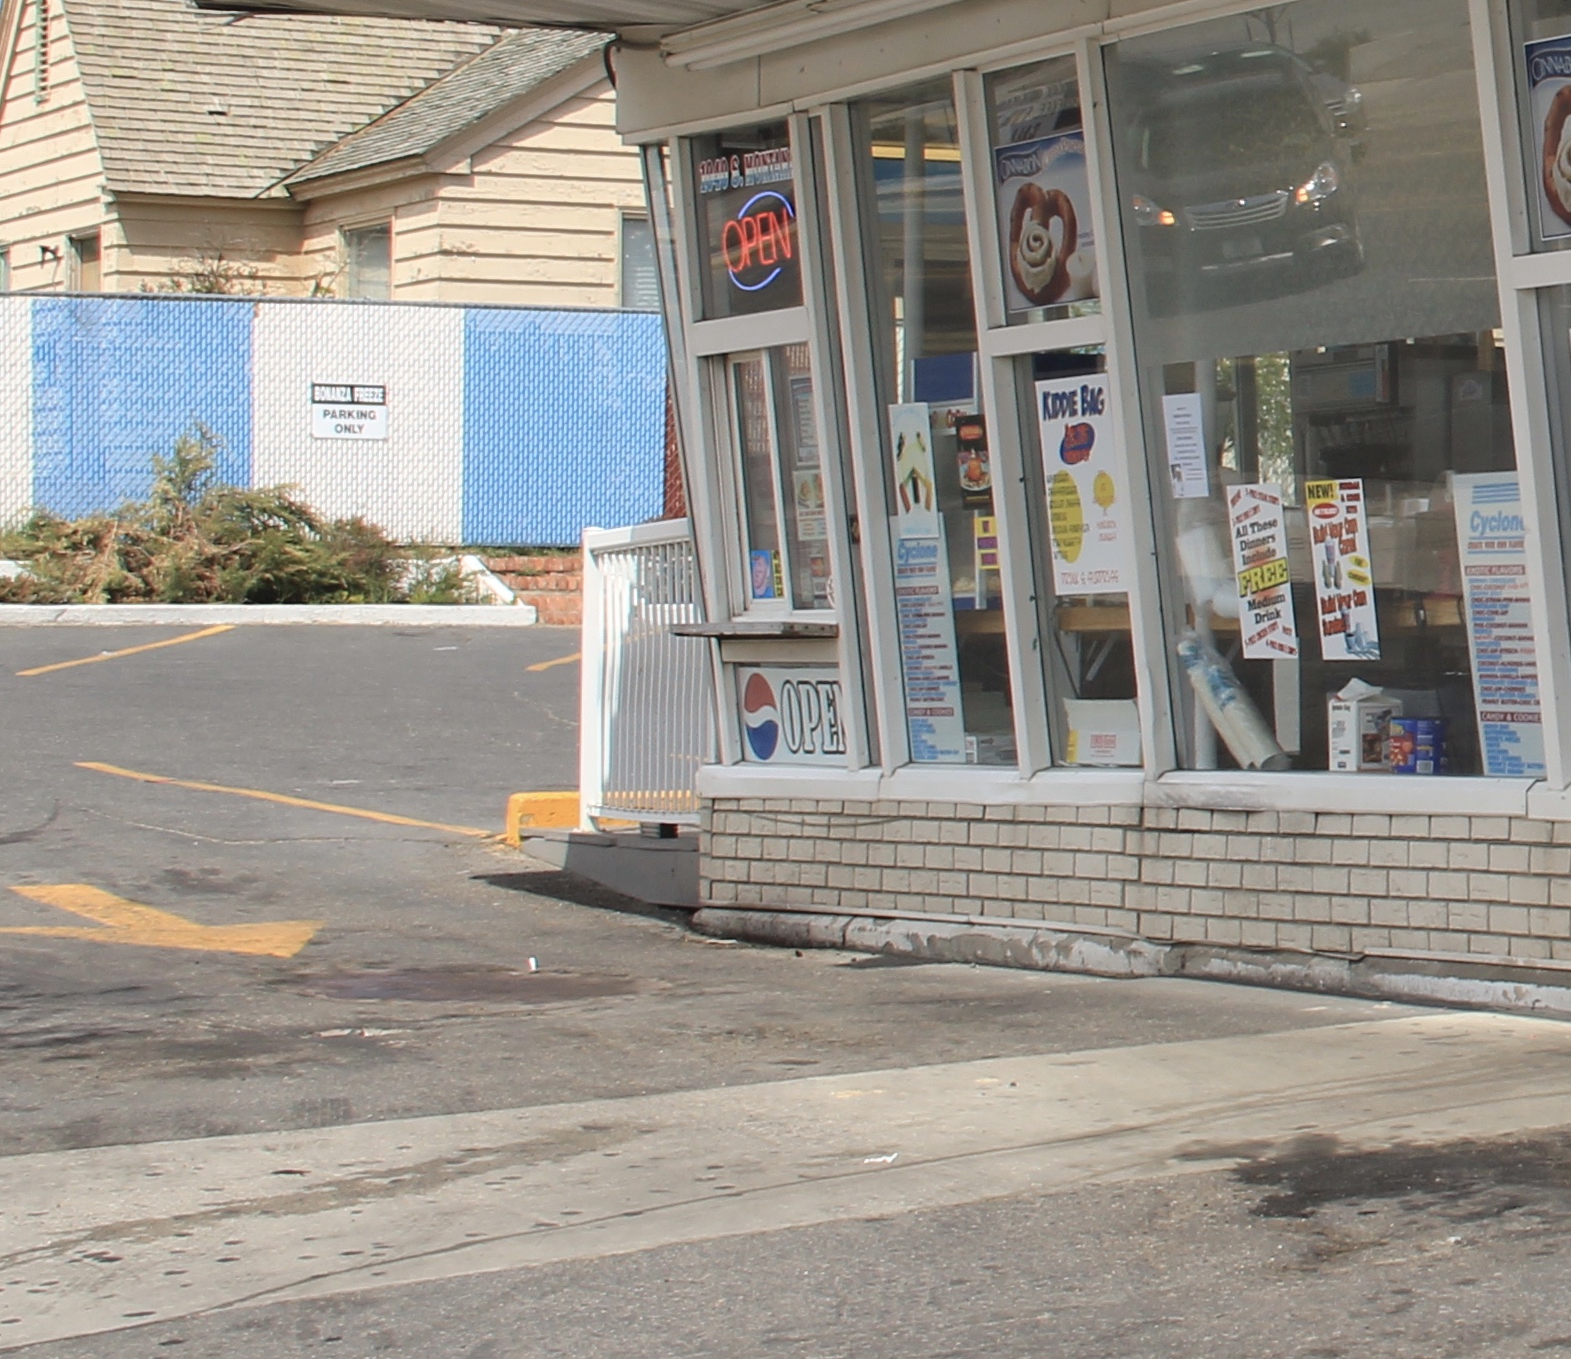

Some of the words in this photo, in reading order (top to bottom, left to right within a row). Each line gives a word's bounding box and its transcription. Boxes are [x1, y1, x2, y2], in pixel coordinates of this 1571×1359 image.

[721, 207, 792, 273] OPEN
[314, 385, 352, 402] BONANZA
[354, 386, 384, 403] FREEZE
[1080, 384, 1104, 417] BAG
[323, 409, 377, 420] PARKING
[334, 423, 365, 434] ONLY
[1307, 483, 1334, 499] NEW!
[1236, 524, 1249, 539] All
[1249, 518, 1278, 534] These
[1240, 534, 1276, 552] Dinners
[1237, 556, 1290, 598] FREE
[1247, 593, 1286, 612] Medium
[1254, 608, 1282, 624] Drink
